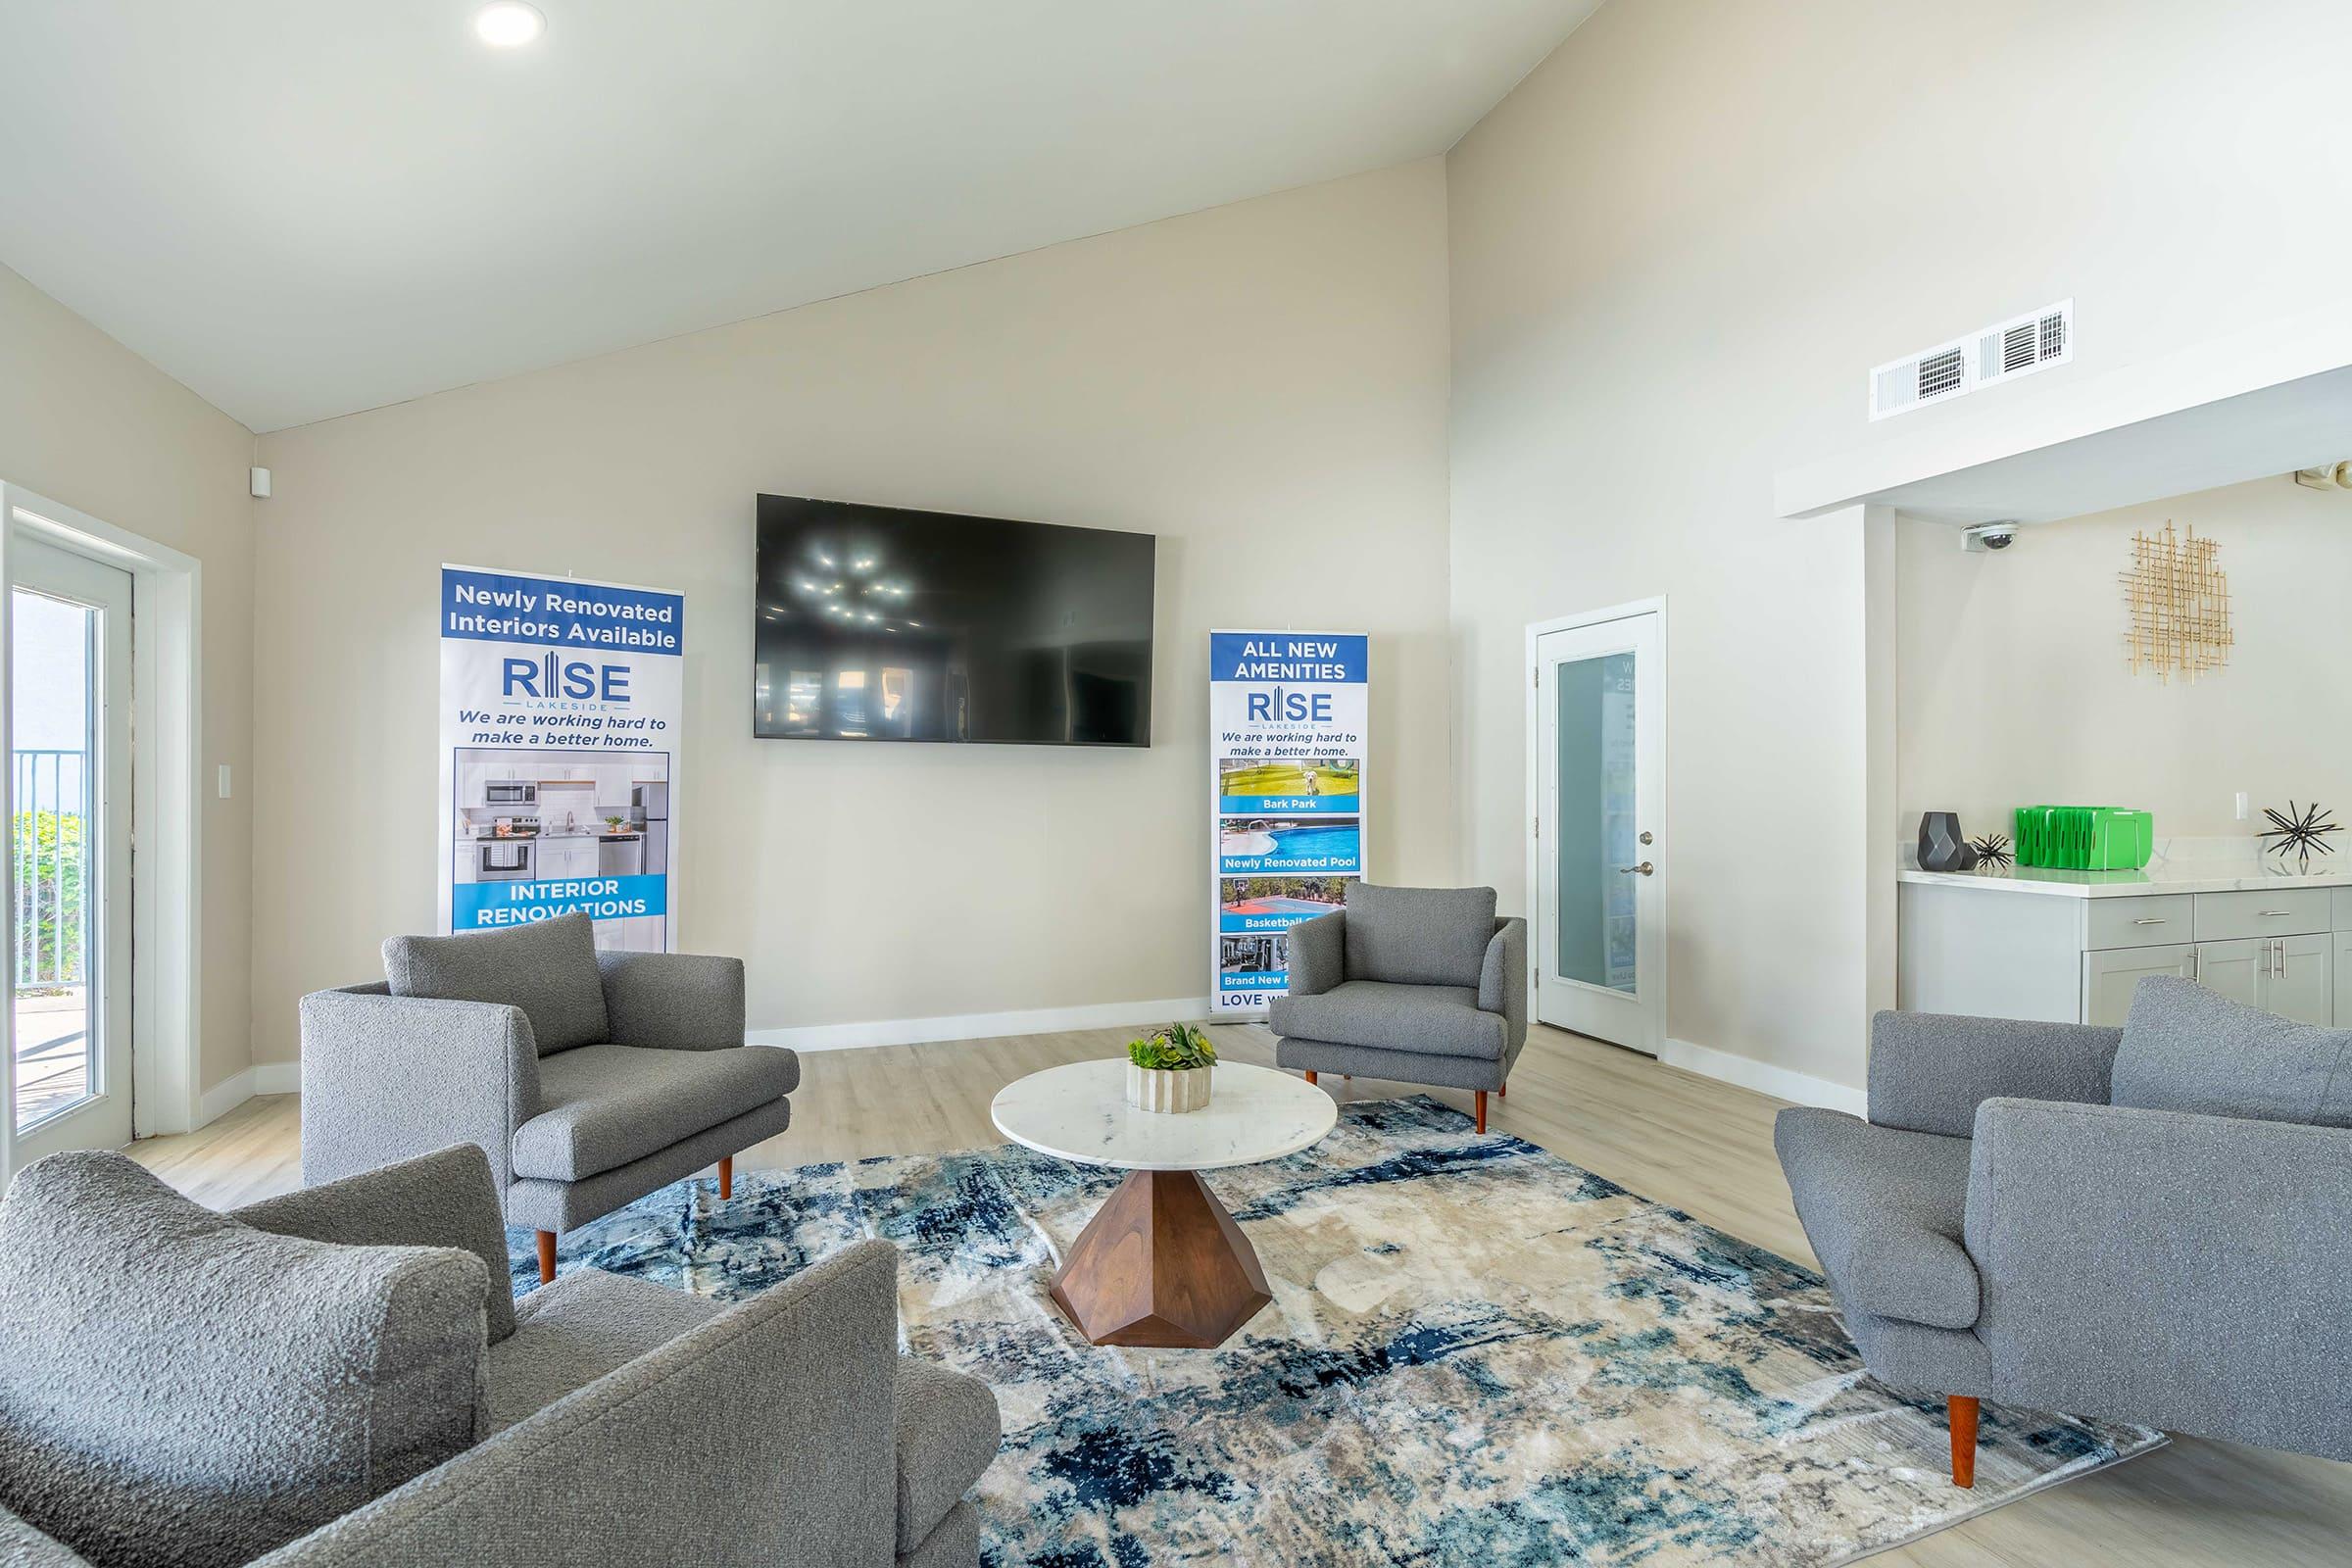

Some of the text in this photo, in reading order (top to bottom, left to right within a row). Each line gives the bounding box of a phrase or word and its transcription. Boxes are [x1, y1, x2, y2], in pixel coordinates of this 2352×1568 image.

[455, 584, 672, 623] Newly Renovated
[450, 612, 676, 648] Interiors Available
[1243, 642, 1337, 658] ALL NEW
[503, 651, 630, 702] RISE
[1235, 662, 1346, 679] AMENITIES
[526, 702, 607, 711] LAKESIDE
[1248, 686, 1332, 721] RISE
[460, 710, 666, 730] We are working hard to
[471, 731, 654, 747] make a better home.
[1222, 732, 1242, 741] We
[1266, 733, 1314, 743] working
[1316, 732, 1343, 742] hard
[1346, 733, 1356, 742] to
[1230, 747, 1261, 756] make
[1275, 747, 1310, 756] better
[1313, 747, 1348, 756] home.
[1264, 800, 1288, 808] Bark
[1225, 857, 1355, 868] Newly Renovated Pool
[511, 880, 618, 901] INTERIOR
[477, 899, 646, 924] RENOVATIONS
[1246, 918, 1301, 928] Basketball
[1225, 976, 1254, 985] Brand
[1222, 994, 1262, 1005] LOVE
